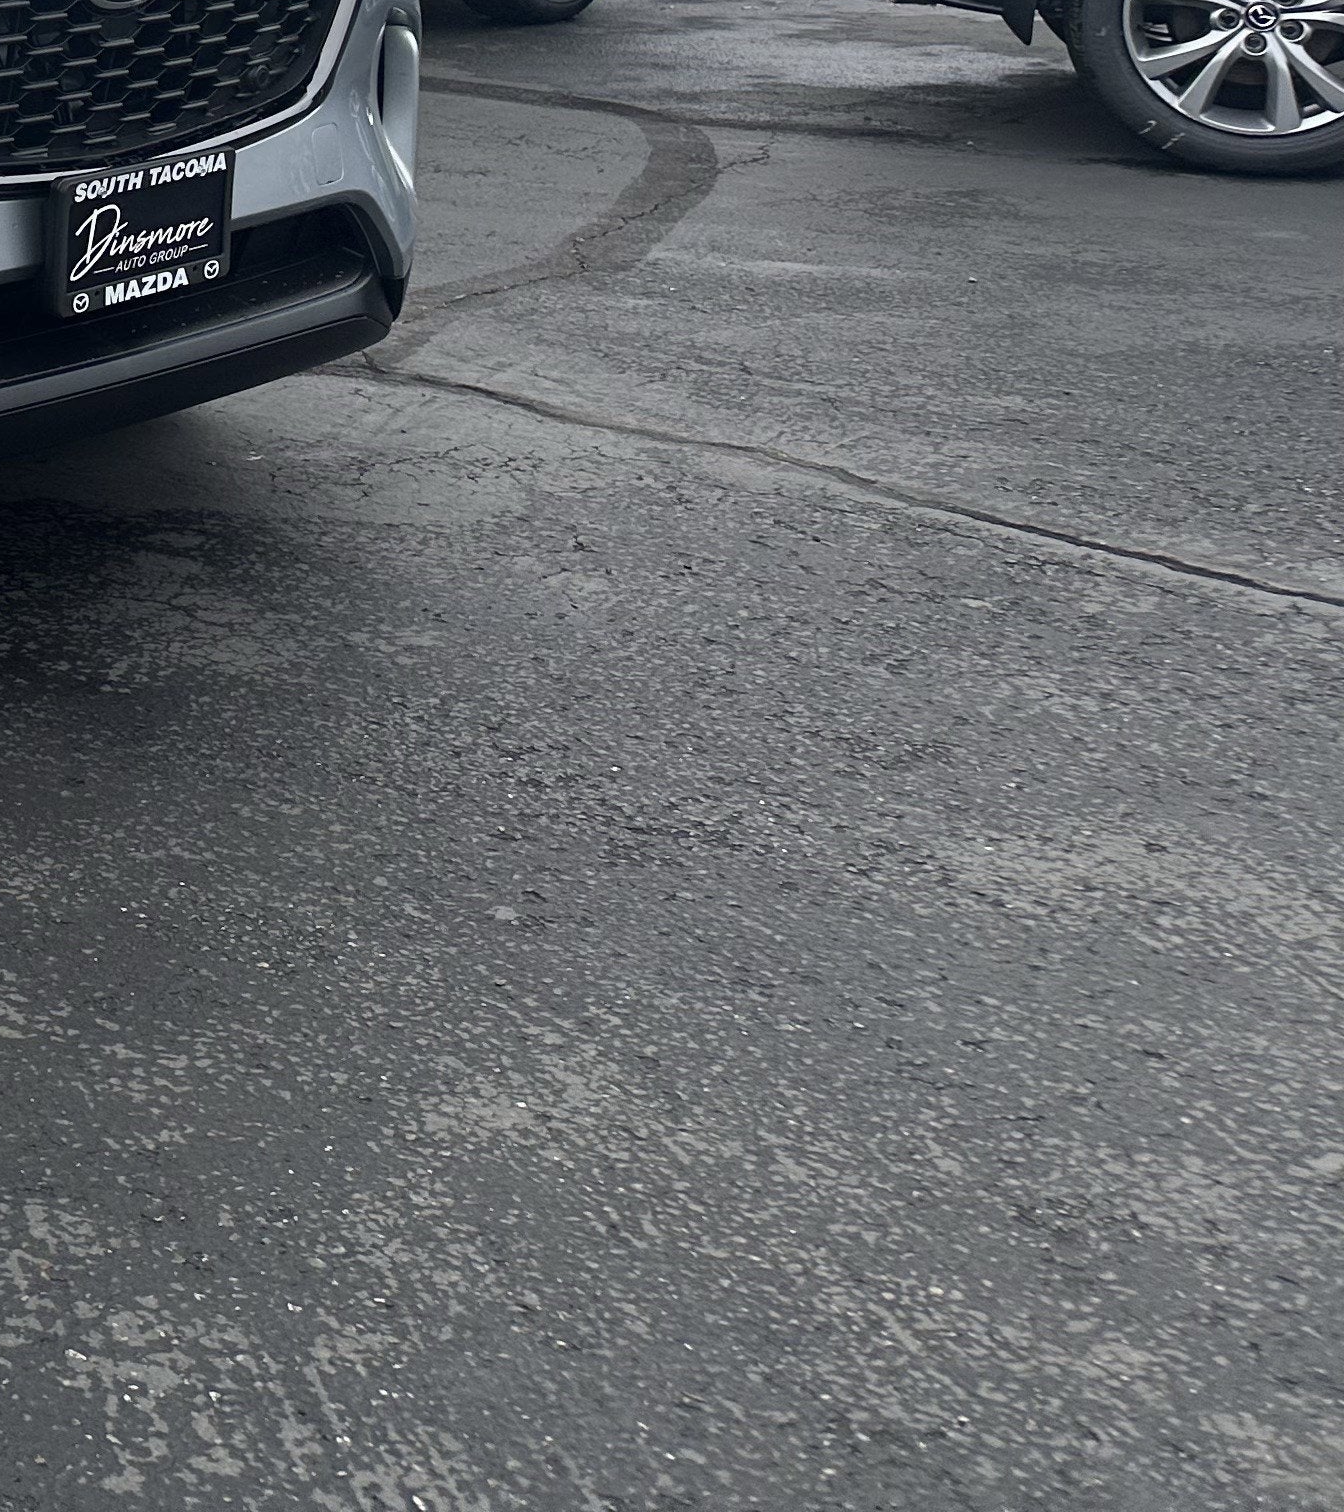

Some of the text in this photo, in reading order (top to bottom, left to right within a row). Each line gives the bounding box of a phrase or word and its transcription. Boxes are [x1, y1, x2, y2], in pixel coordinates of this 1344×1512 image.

[74, 152, 227, 204] SOUTH TACOMA
[69, 204, 214, 282] Dinsmore
[115, 244, 189, 273] AUTO GROUP
[105, 267, 190, 307] MAZDA
